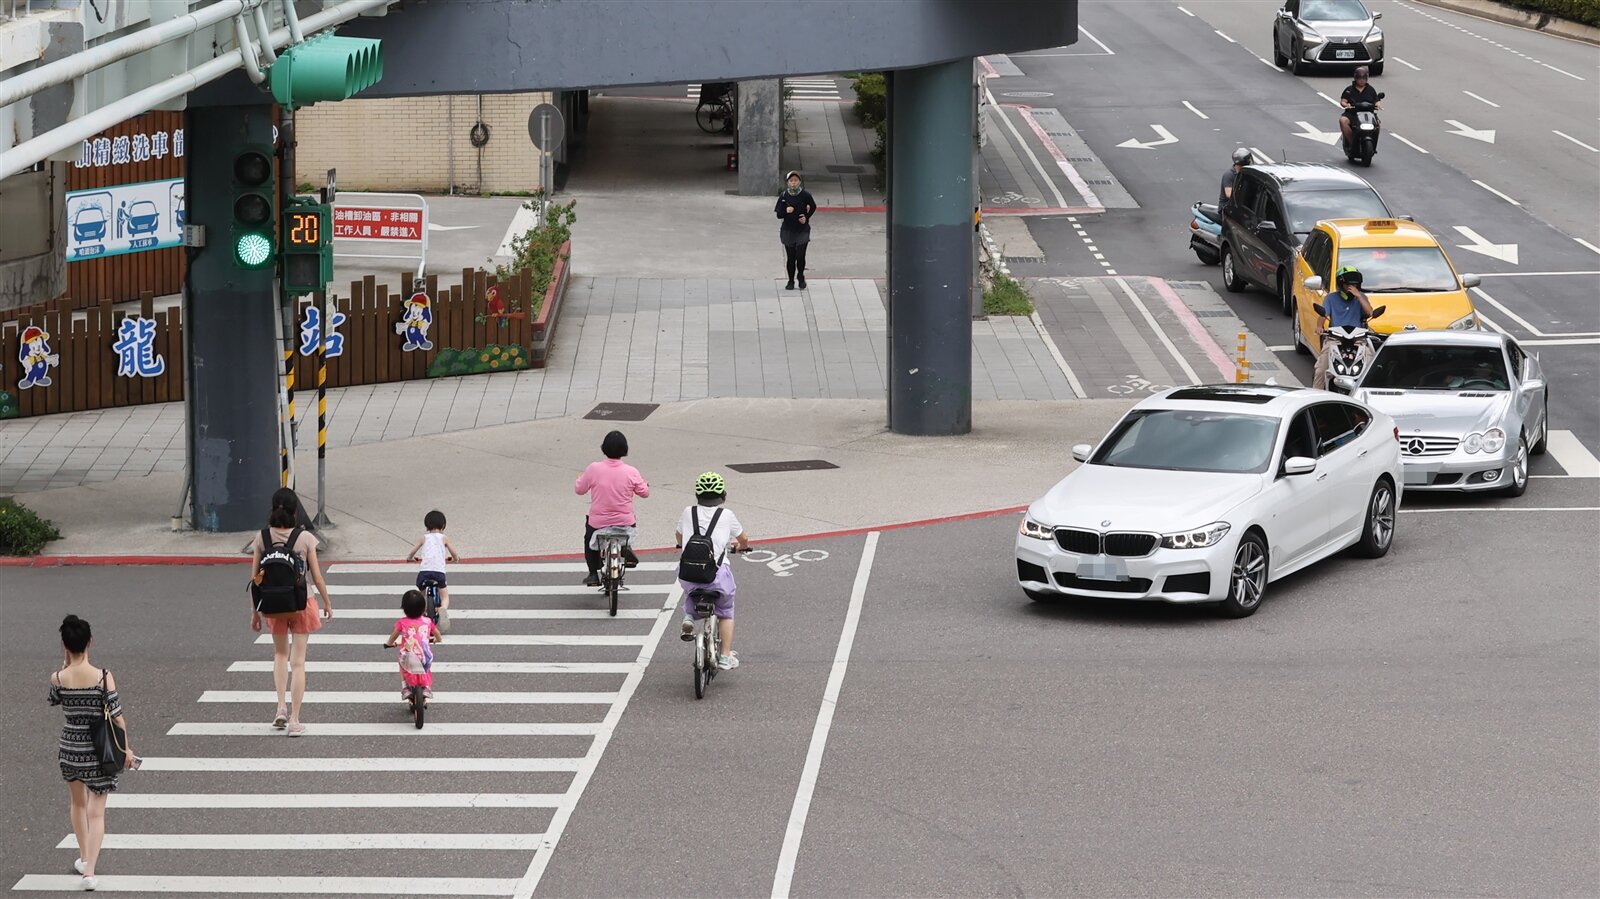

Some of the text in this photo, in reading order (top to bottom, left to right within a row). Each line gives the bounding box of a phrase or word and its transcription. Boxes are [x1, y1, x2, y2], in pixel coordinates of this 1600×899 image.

[291, 214, 318, 244] 20
[113, 306, 346, 378] 龍 站
